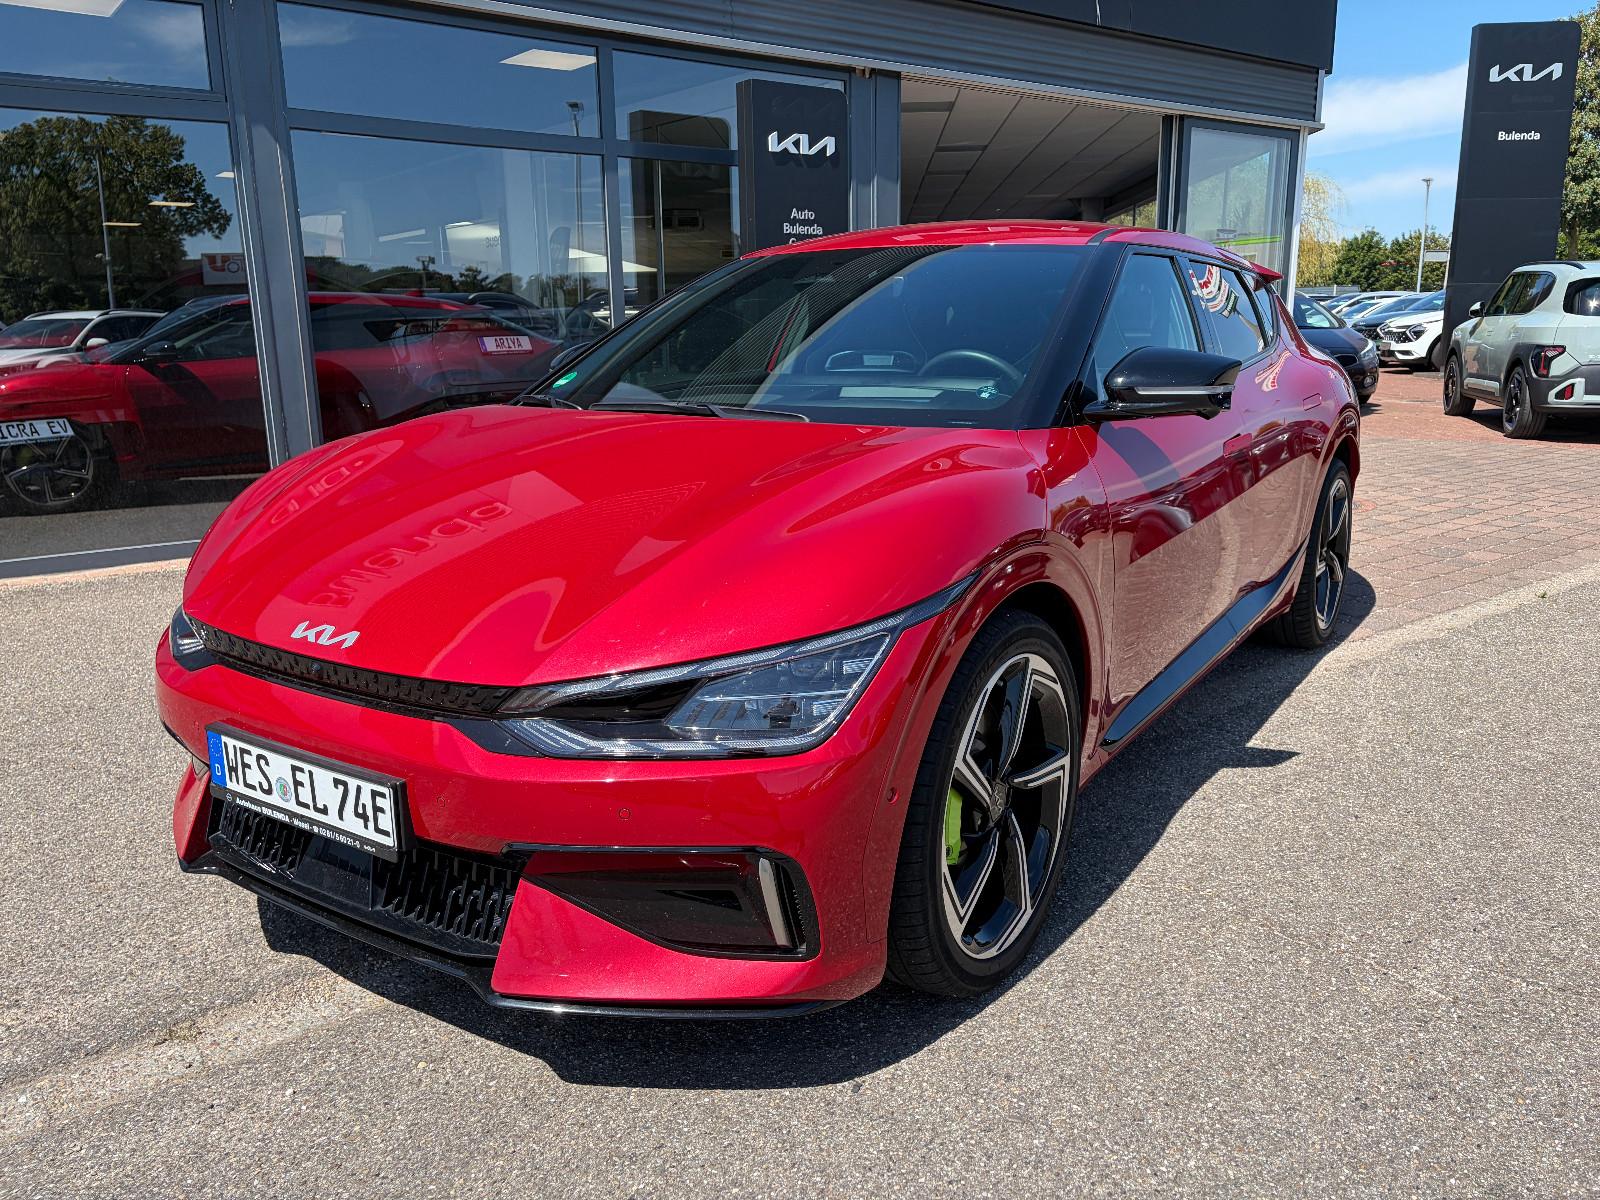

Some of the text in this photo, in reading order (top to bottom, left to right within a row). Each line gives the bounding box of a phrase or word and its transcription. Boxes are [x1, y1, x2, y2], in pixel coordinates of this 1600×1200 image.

[1489, 62, 1563, 82] KIA
[1497, 130, 1541, 141] Bulenda
[768, 130, 836, 157] KIA
[790, 207, 816, 220] Auto
[783, 222, 823, 235] Bulenda
[494, 337, 524, 350] ARIYA
[47, 420, 68, 435] EV
[290, 620, 360, 649] KIA
[215, 763, 222, 776] D
[223, 740, 392, 838] WES EL 74E
